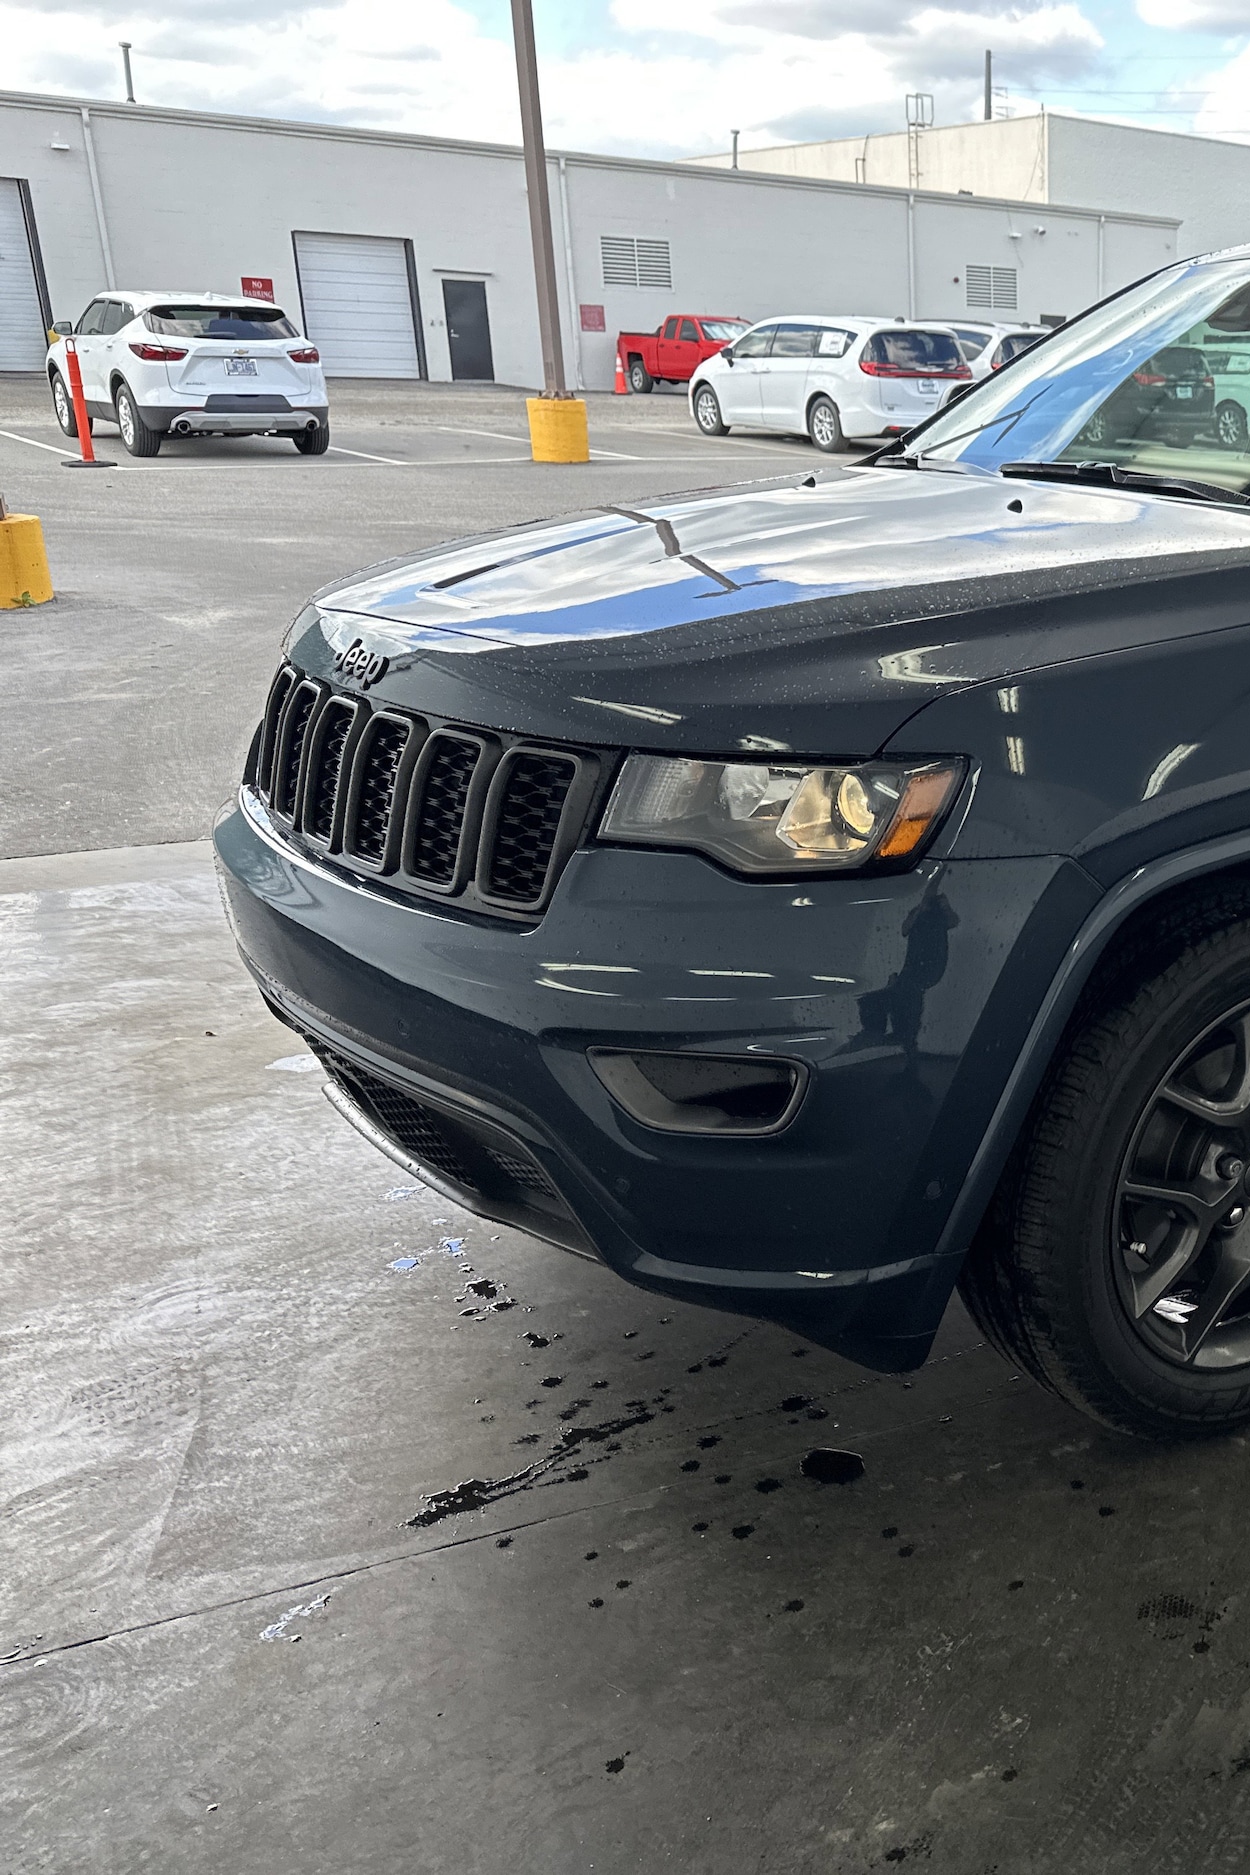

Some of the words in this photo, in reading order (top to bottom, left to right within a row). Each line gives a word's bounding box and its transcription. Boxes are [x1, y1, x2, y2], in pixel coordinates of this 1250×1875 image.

[251, 280, 263, 289] NO
[243, 289, 273, 299] PARKING
[332, 638, 389, 691] Jeep
